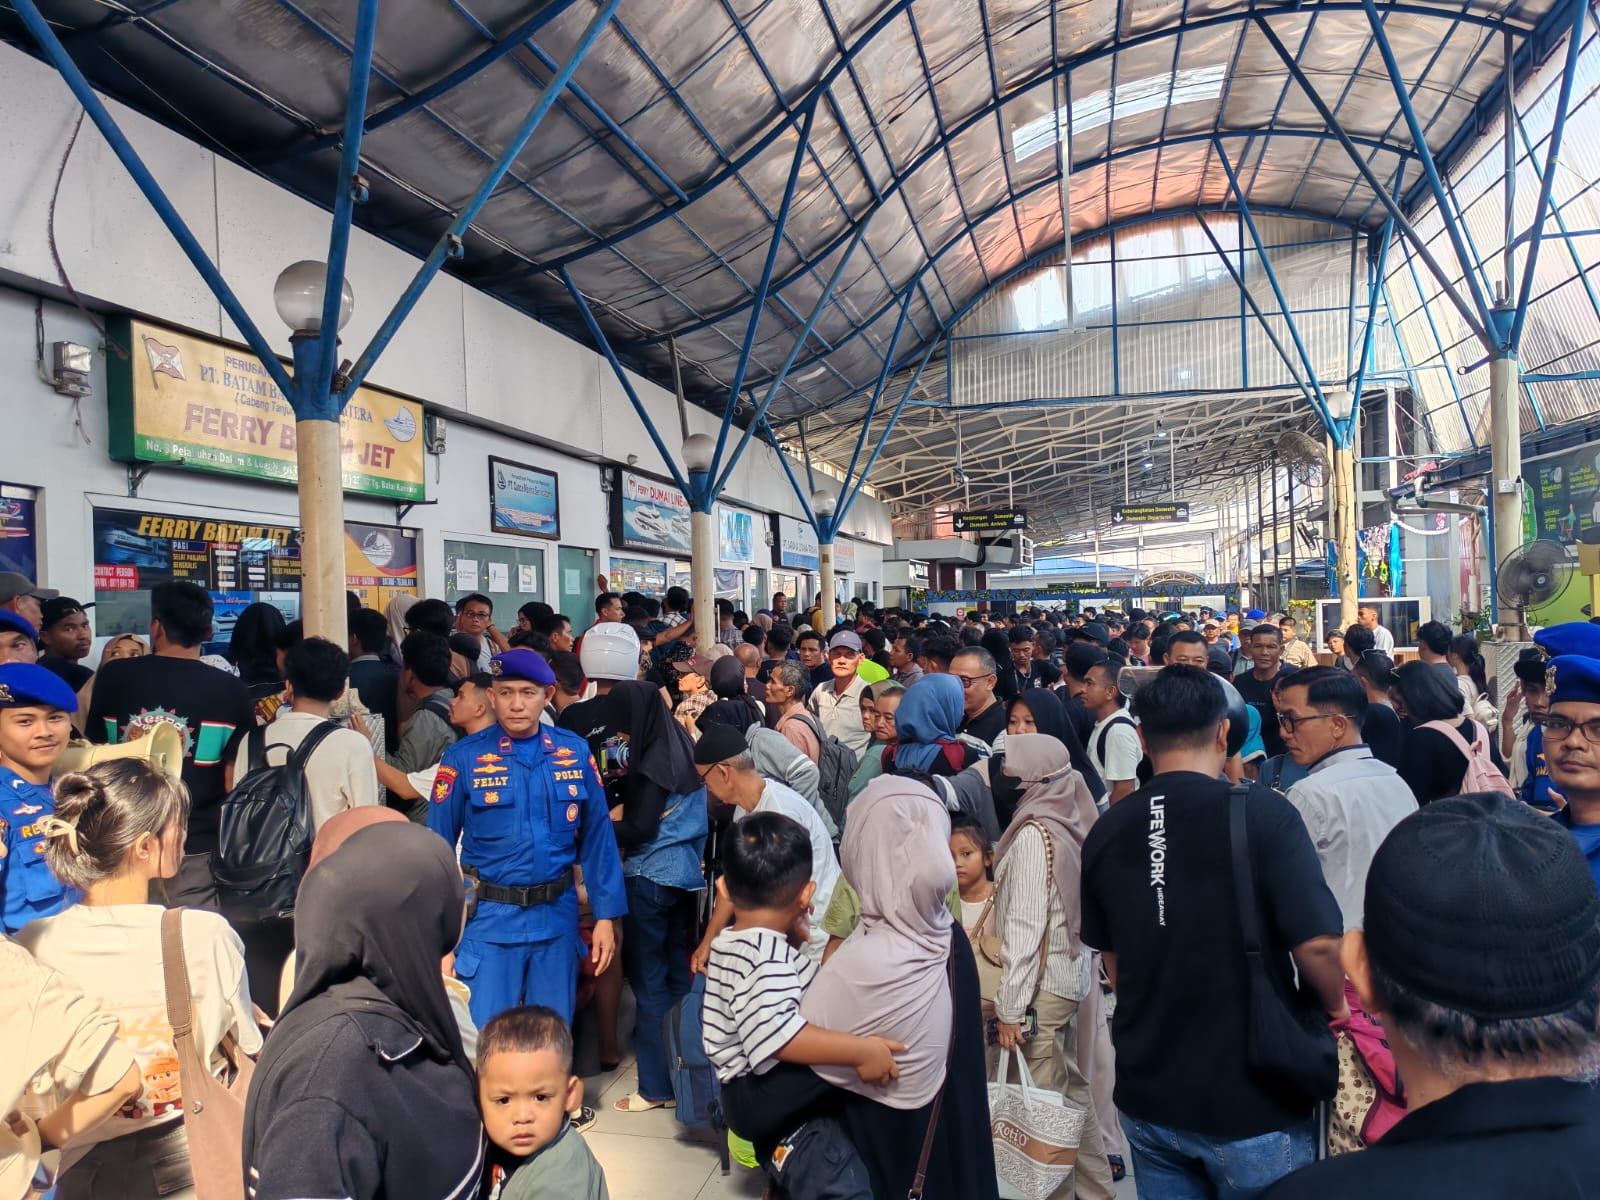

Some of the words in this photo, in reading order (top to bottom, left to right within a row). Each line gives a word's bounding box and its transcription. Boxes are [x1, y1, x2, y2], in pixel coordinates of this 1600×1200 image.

[200, 365, 219, 385] PT.
[223, 371, 267, 397] BATAM
[184, 403, 275, 446] FERRY
[358, 442, 396, 470] JET
[146, 439, 162, 453] No.
[650, 486, 670, 504] DUMAI
[137, 516, 201, 540] FERRY
[203, 522, 264, 543] BATAM
[266, 527, 292, 547] JET
[172, 541, 189, 551] PAGI
[116, 567, 134, 577] PERSON
[472, 776, 509, 789] FELLY
[554, 769, 584, 781] POLRI
[1148, 795, 1167, 887] LIFEWORK
[1156, 887, 1167, 927] HIDEAWAY
